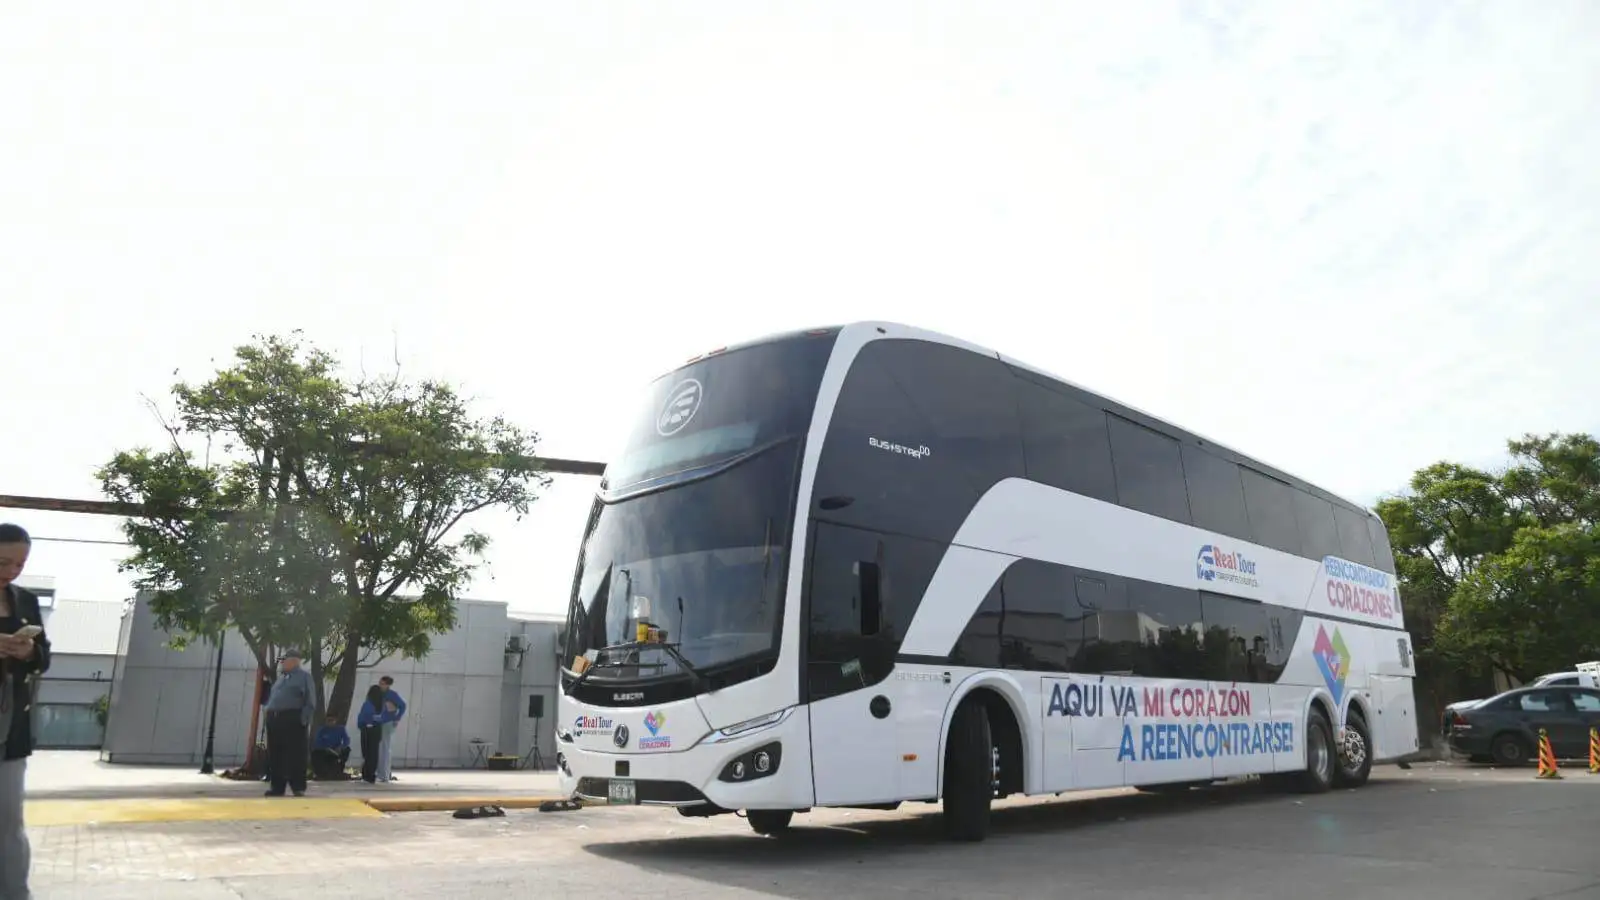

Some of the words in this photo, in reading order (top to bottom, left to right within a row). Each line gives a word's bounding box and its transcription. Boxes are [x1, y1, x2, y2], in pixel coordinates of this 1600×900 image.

[1213, 546, 1237, 569] Real
[1237, 553, 1256, 575] Tour
[1327, 580, 1393, 619] CORAZONES
[1047, 676, 1104, 717] AQUÍ
[1110, 685, 1138, 717] VA
[1143, 687, 1164, 717] MI
[1170, 680, 1251, 717] CORAZÓN
[583, 716, 598, 728] Real
[599, 716, 613, 728] Tour
[1117, 724, 1136, 762] A
[1141, 722, 1293, 761] REENCONTRARSE!
